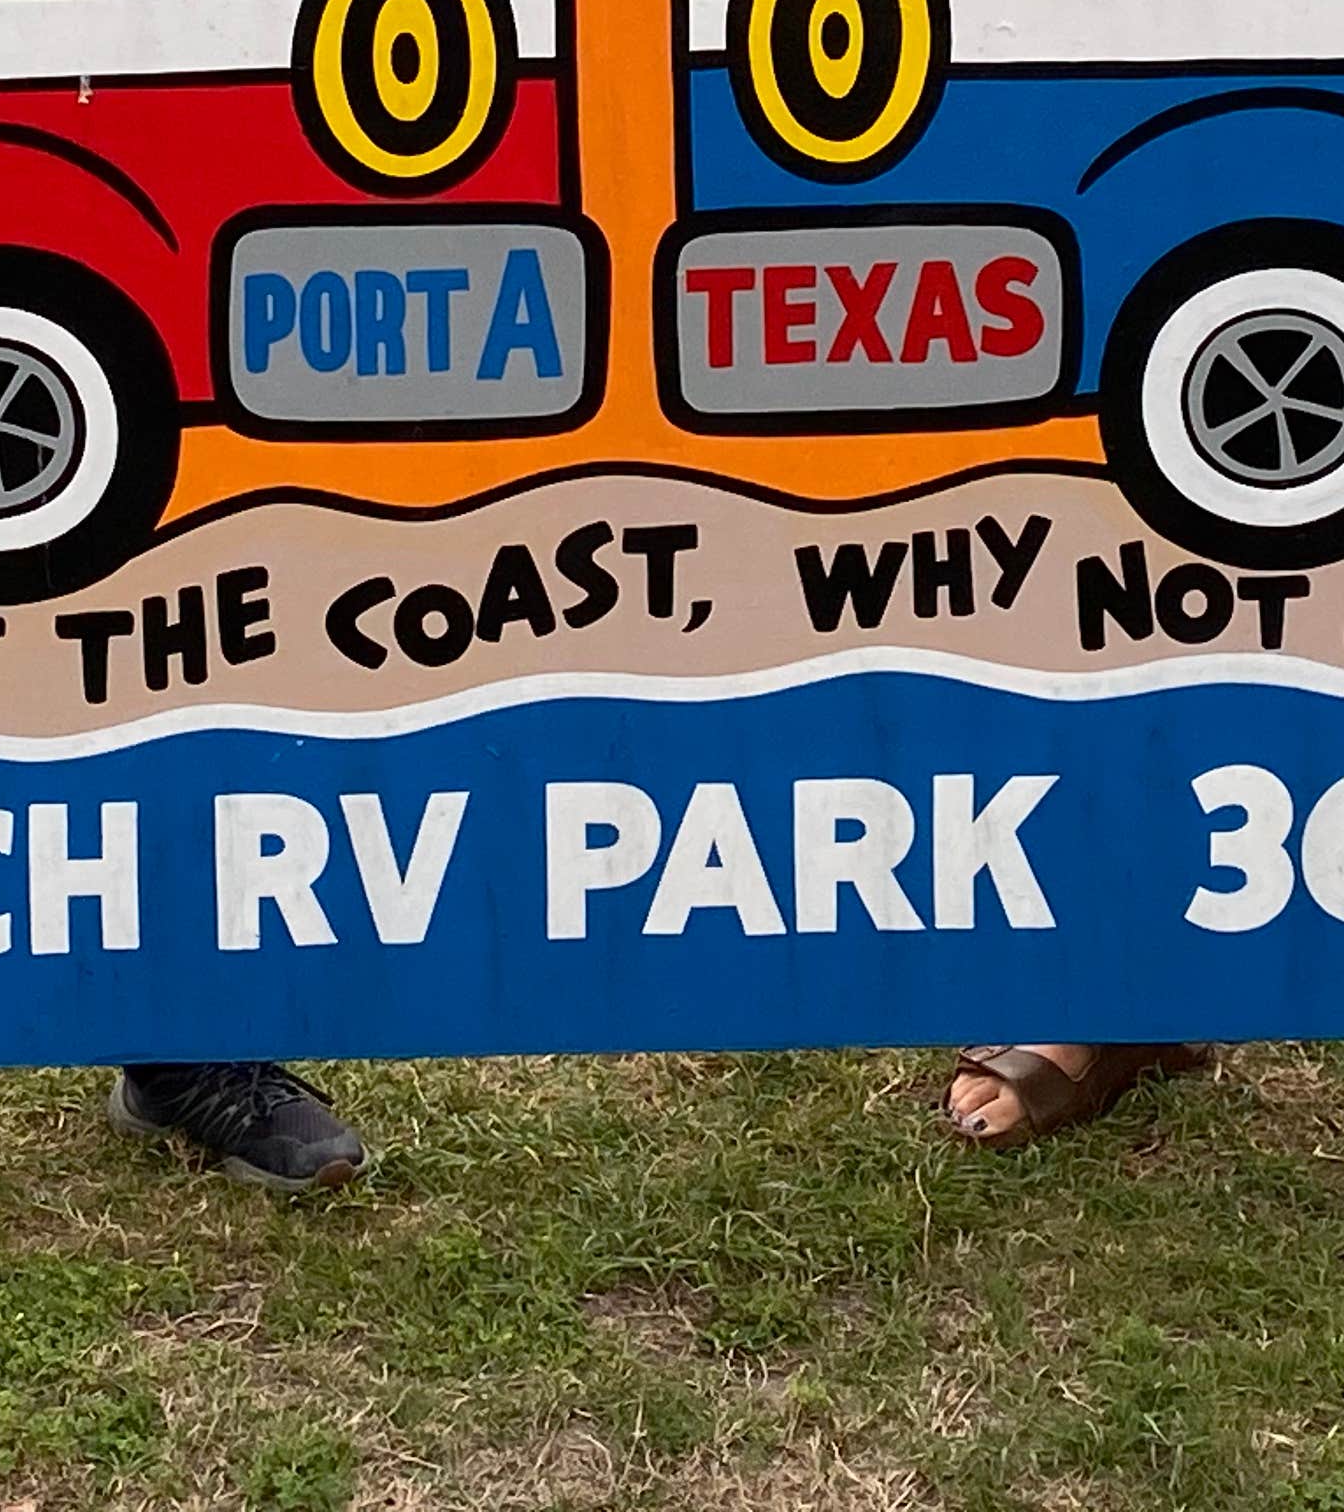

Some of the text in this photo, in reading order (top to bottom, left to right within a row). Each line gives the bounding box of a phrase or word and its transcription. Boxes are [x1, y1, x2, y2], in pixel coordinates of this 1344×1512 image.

[244, 249, 562, 380] PORT A
[685, 256, 1045, 367] TEXAS
[55, 567, 276, 704] THE
[325, 521, 713, 670] COAST,
[794, 515, 1052, 633] WHY
[1076, 541, 1311, 652] NOT
[215, 792, 470, 950] RV
[546, 774, 1060, 940] PARK
